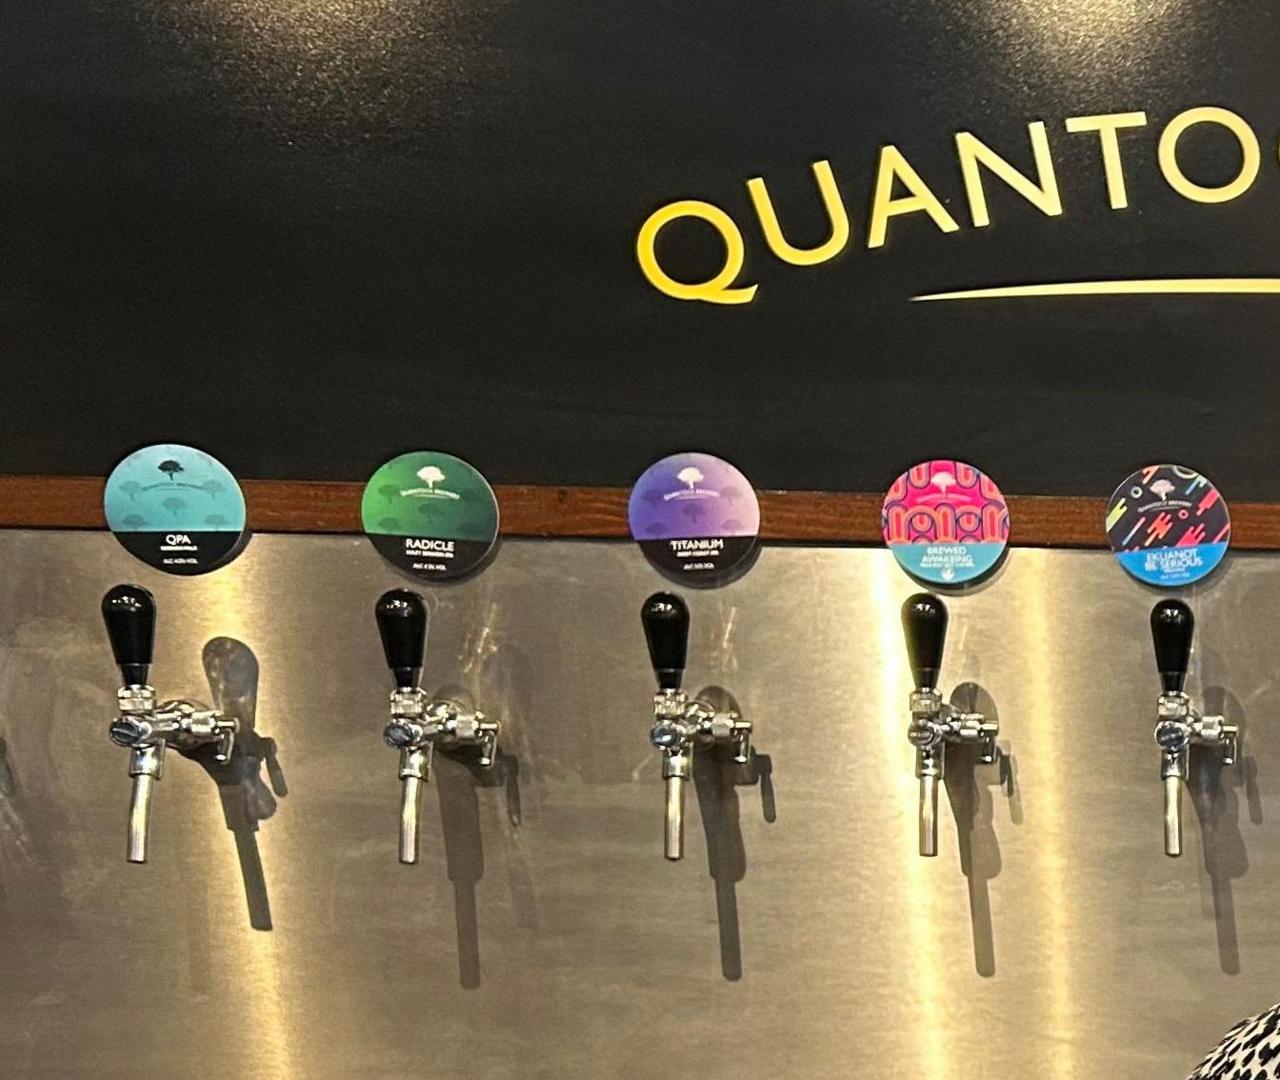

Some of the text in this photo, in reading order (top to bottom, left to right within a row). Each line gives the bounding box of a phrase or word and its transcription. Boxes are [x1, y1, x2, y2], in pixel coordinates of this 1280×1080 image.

[165, 533, 192, 546] QPA
[405, 538, 456, 552] RADICLE
[670, 539, 724, 551] TITANIUM
